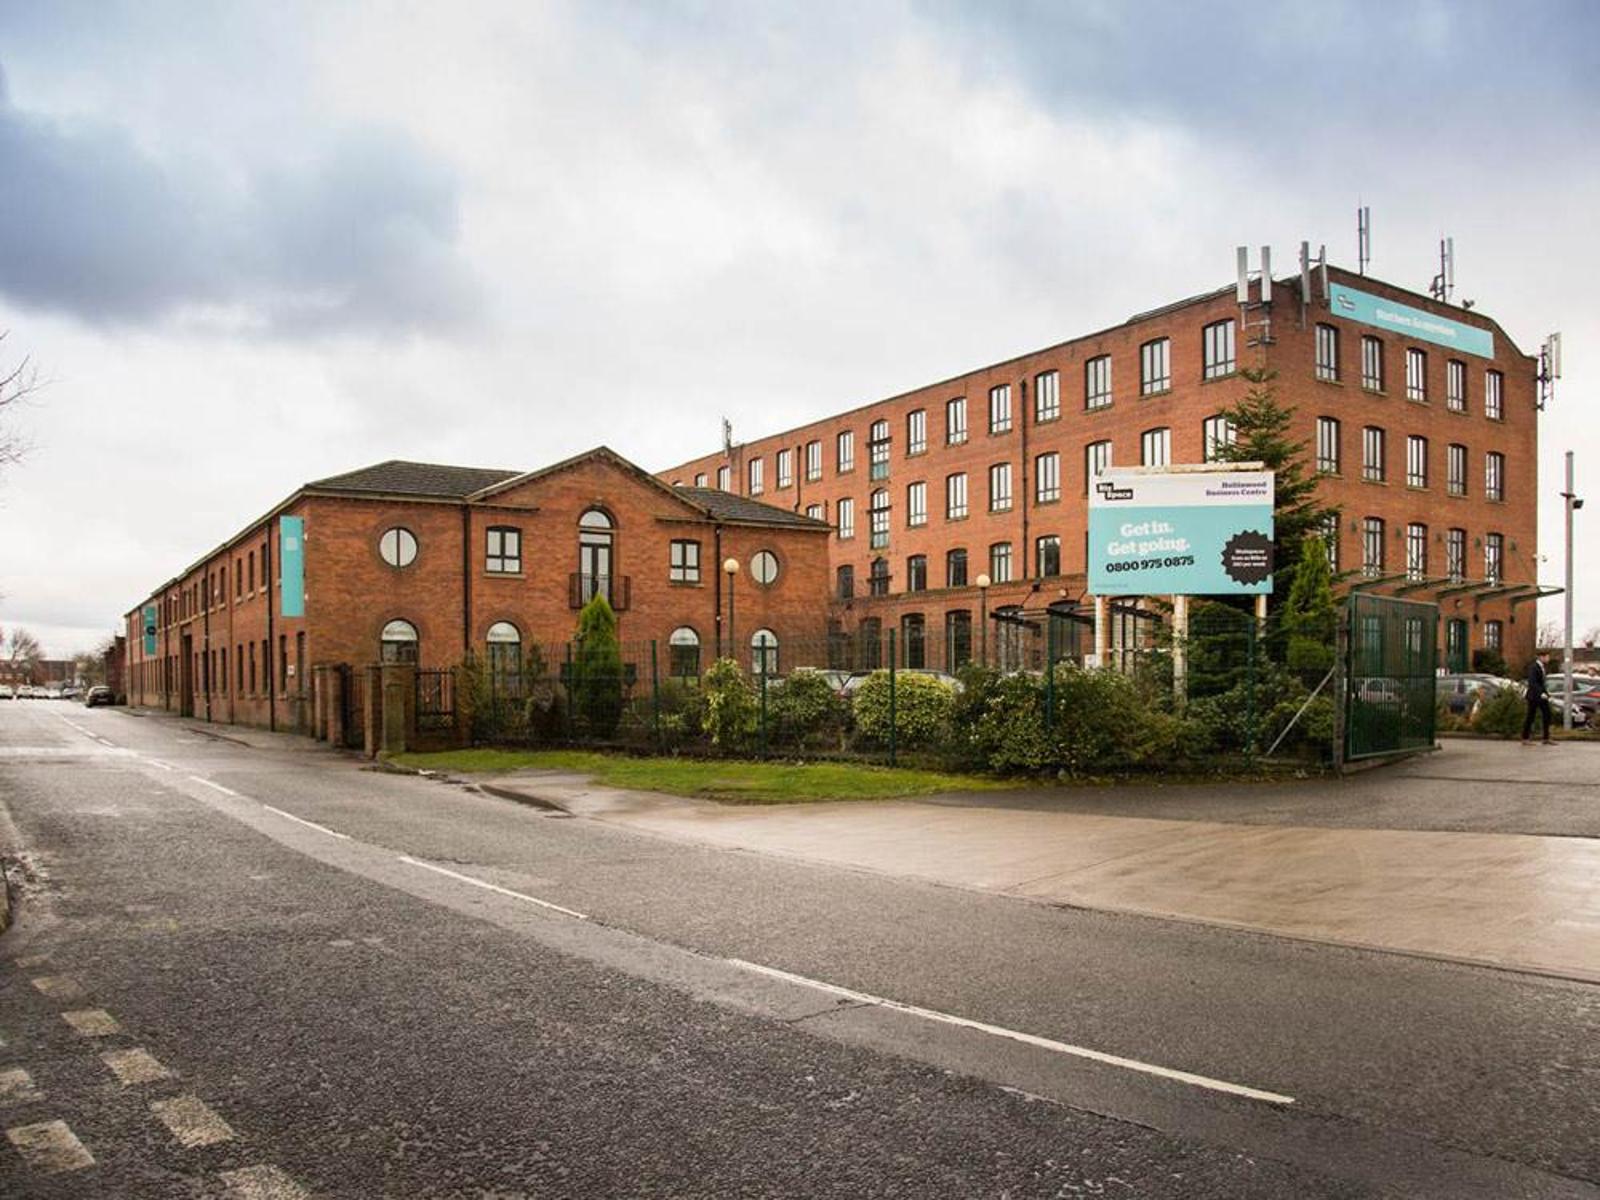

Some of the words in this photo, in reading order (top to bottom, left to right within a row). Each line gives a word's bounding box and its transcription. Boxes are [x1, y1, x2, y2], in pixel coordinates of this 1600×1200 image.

[1206, 489, 1240, 497] Business
[1241, 489, 1267, 497] Centre
[1121, 522, 1150, 538] Get
[1151, 520, 1174, 534] in.
[1107, 541, 1138, 557] Get
[1138, 537, 1191, 556] going.
[1106, 561, 1139, 573] 0800
[1140, 558, 1163, 570] 975
[1163, 555, 1195, 568] 0875
